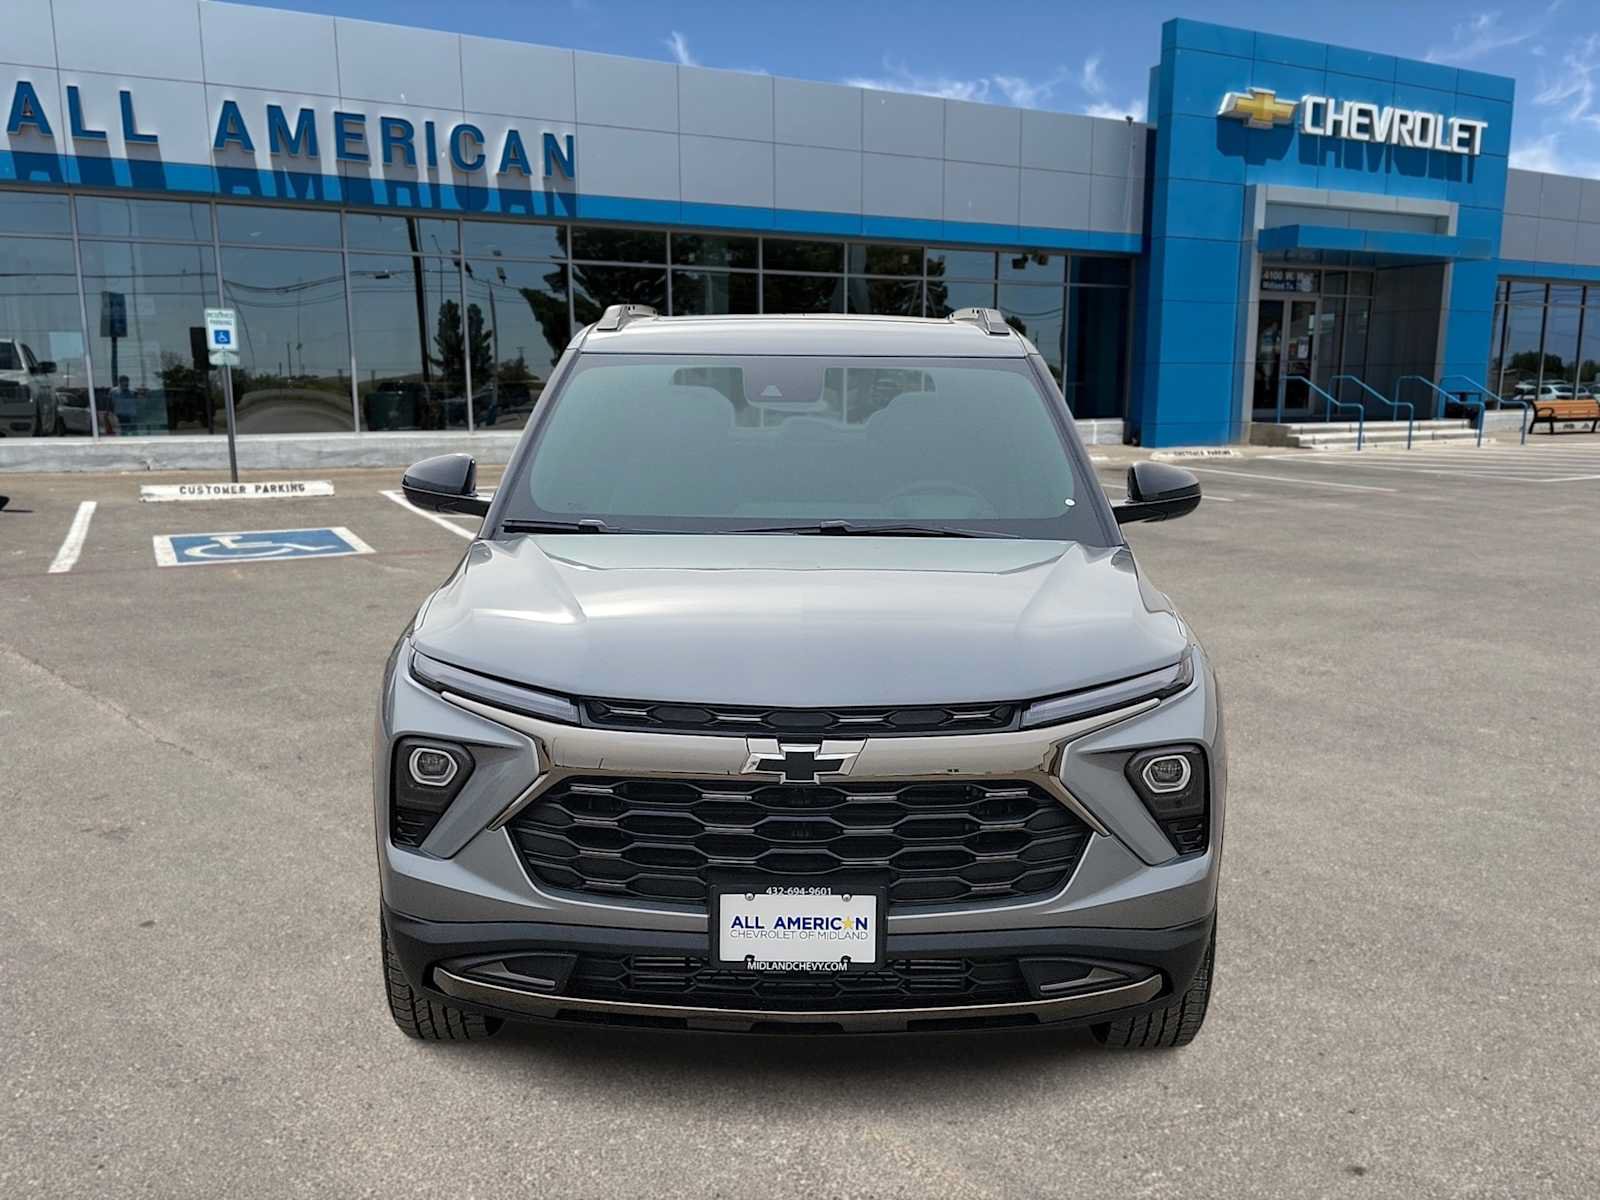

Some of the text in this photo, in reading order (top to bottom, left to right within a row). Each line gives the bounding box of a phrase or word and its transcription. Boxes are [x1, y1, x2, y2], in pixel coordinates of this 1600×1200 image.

[7, 81, 575, 179] ALL AMERICAN
[1302, 94, 1488, 155] CHEVROLET
[179, 483, 306, 496] CUSTOMER PARKING
[766, 886, 832, 896] 432-694-9601
[731, 916, 765, 929] ALL
[730, 929, 868, 940] CHEVROLET OF MIDLAND
[747, 961, 848, 971] MIDLANDCHEVY.COM
